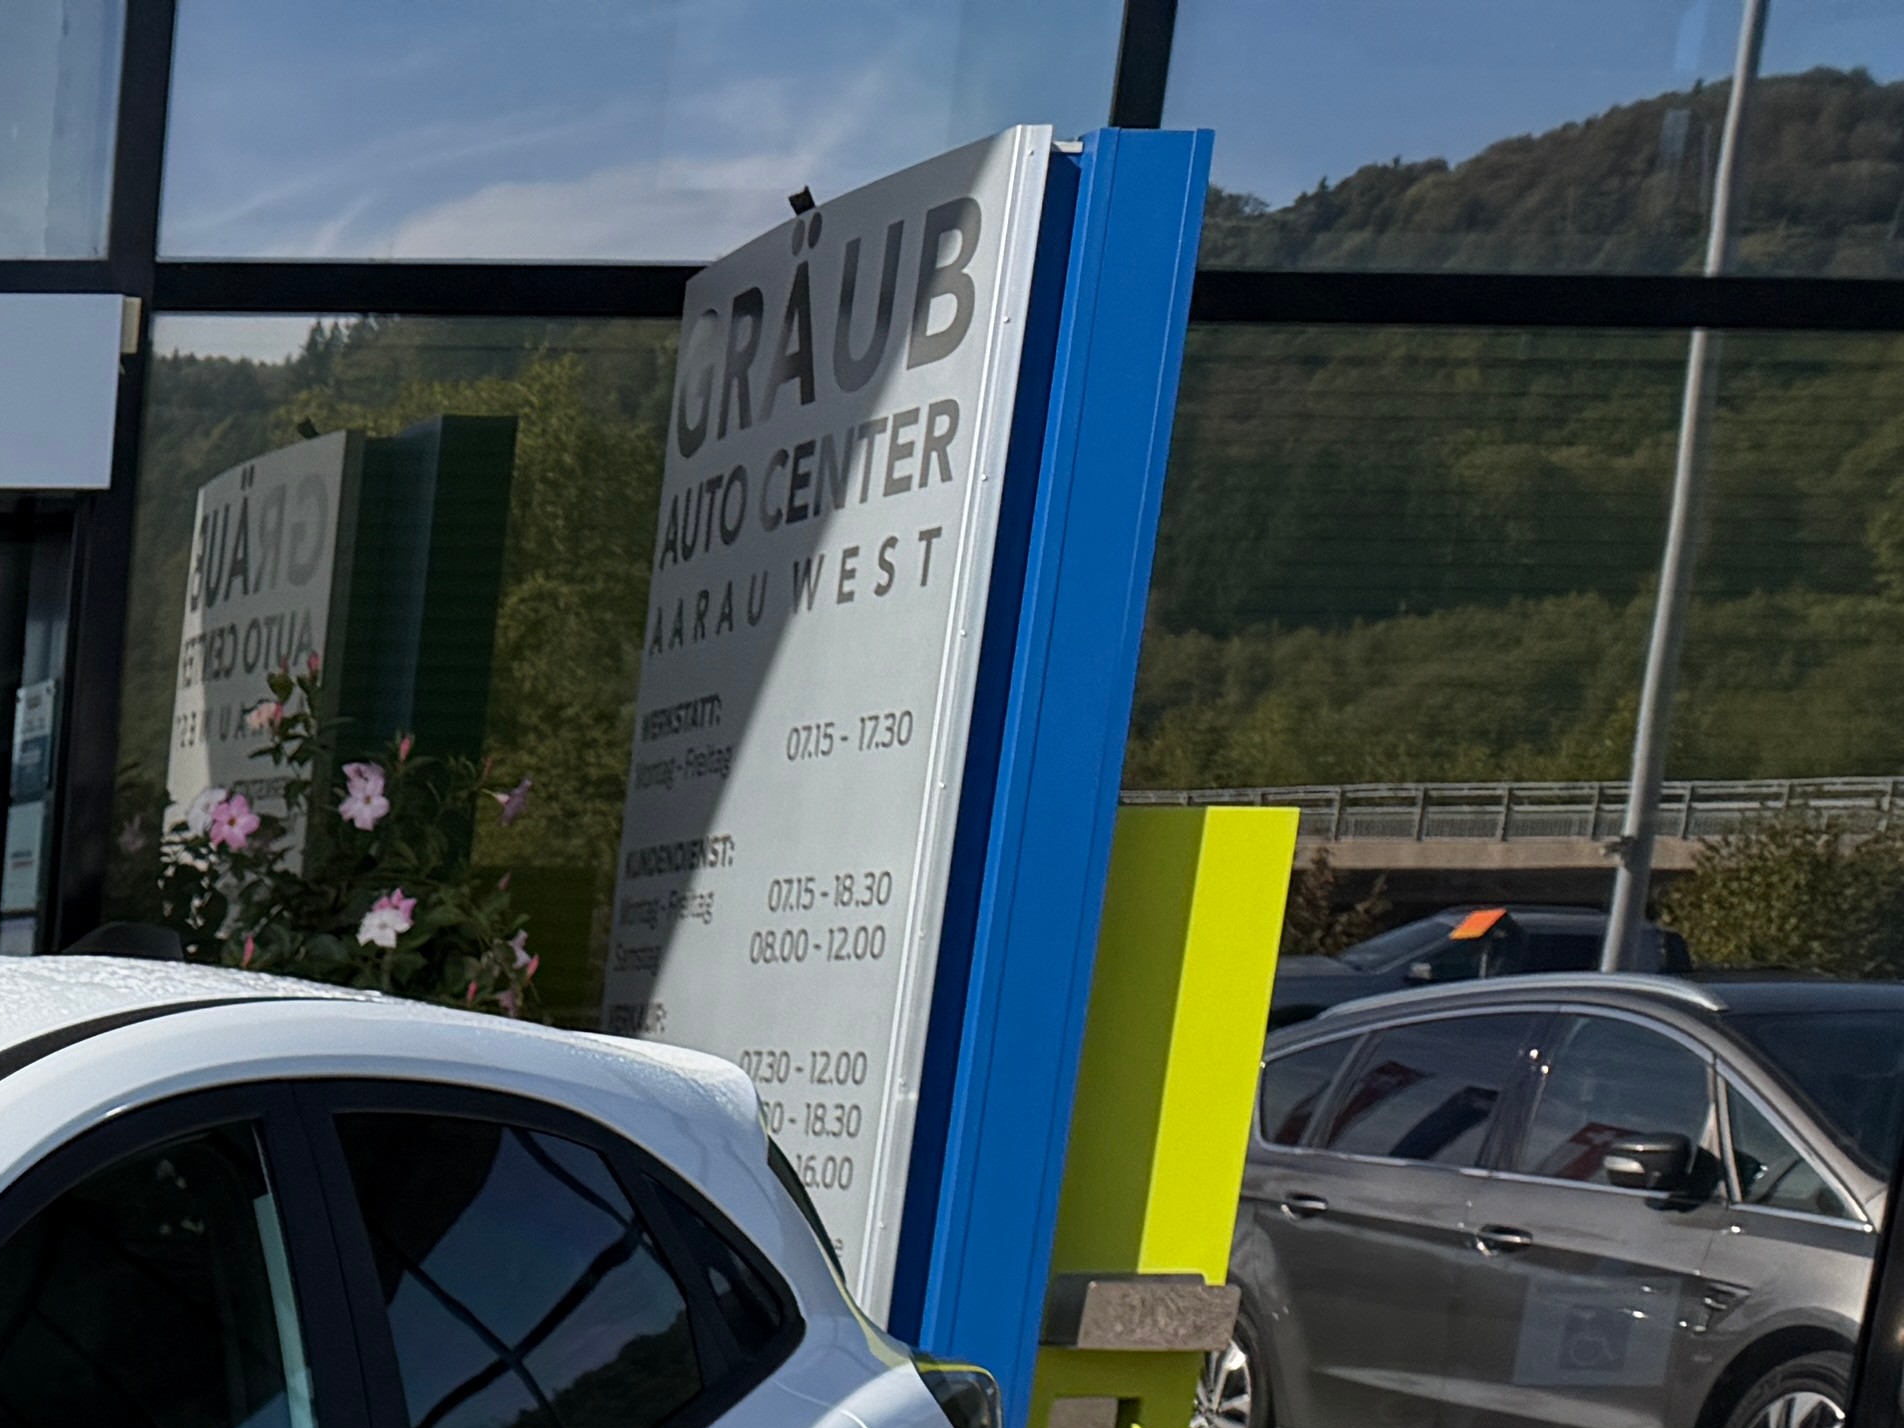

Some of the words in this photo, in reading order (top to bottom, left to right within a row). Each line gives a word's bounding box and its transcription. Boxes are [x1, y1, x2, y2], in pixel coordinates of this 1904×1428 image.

[677, 197, 982, 459] GRÄUB
[659, 463, 749, 572] AUTO
[758, 398, 960, 533] CENTER
[649, 570, 768, 657] AARAU
[792, 526, 943, 616] WEST
[858, 710, 913, 752] 17.30
[833, 871, 892, 908] 18.30
[749, 927, 809, 965] 08.00
[827, 924, 886, 963] 12.00
[810, 1050, 868, 1087] 12.00
[804, 1101, 863, 1140] 18.30
